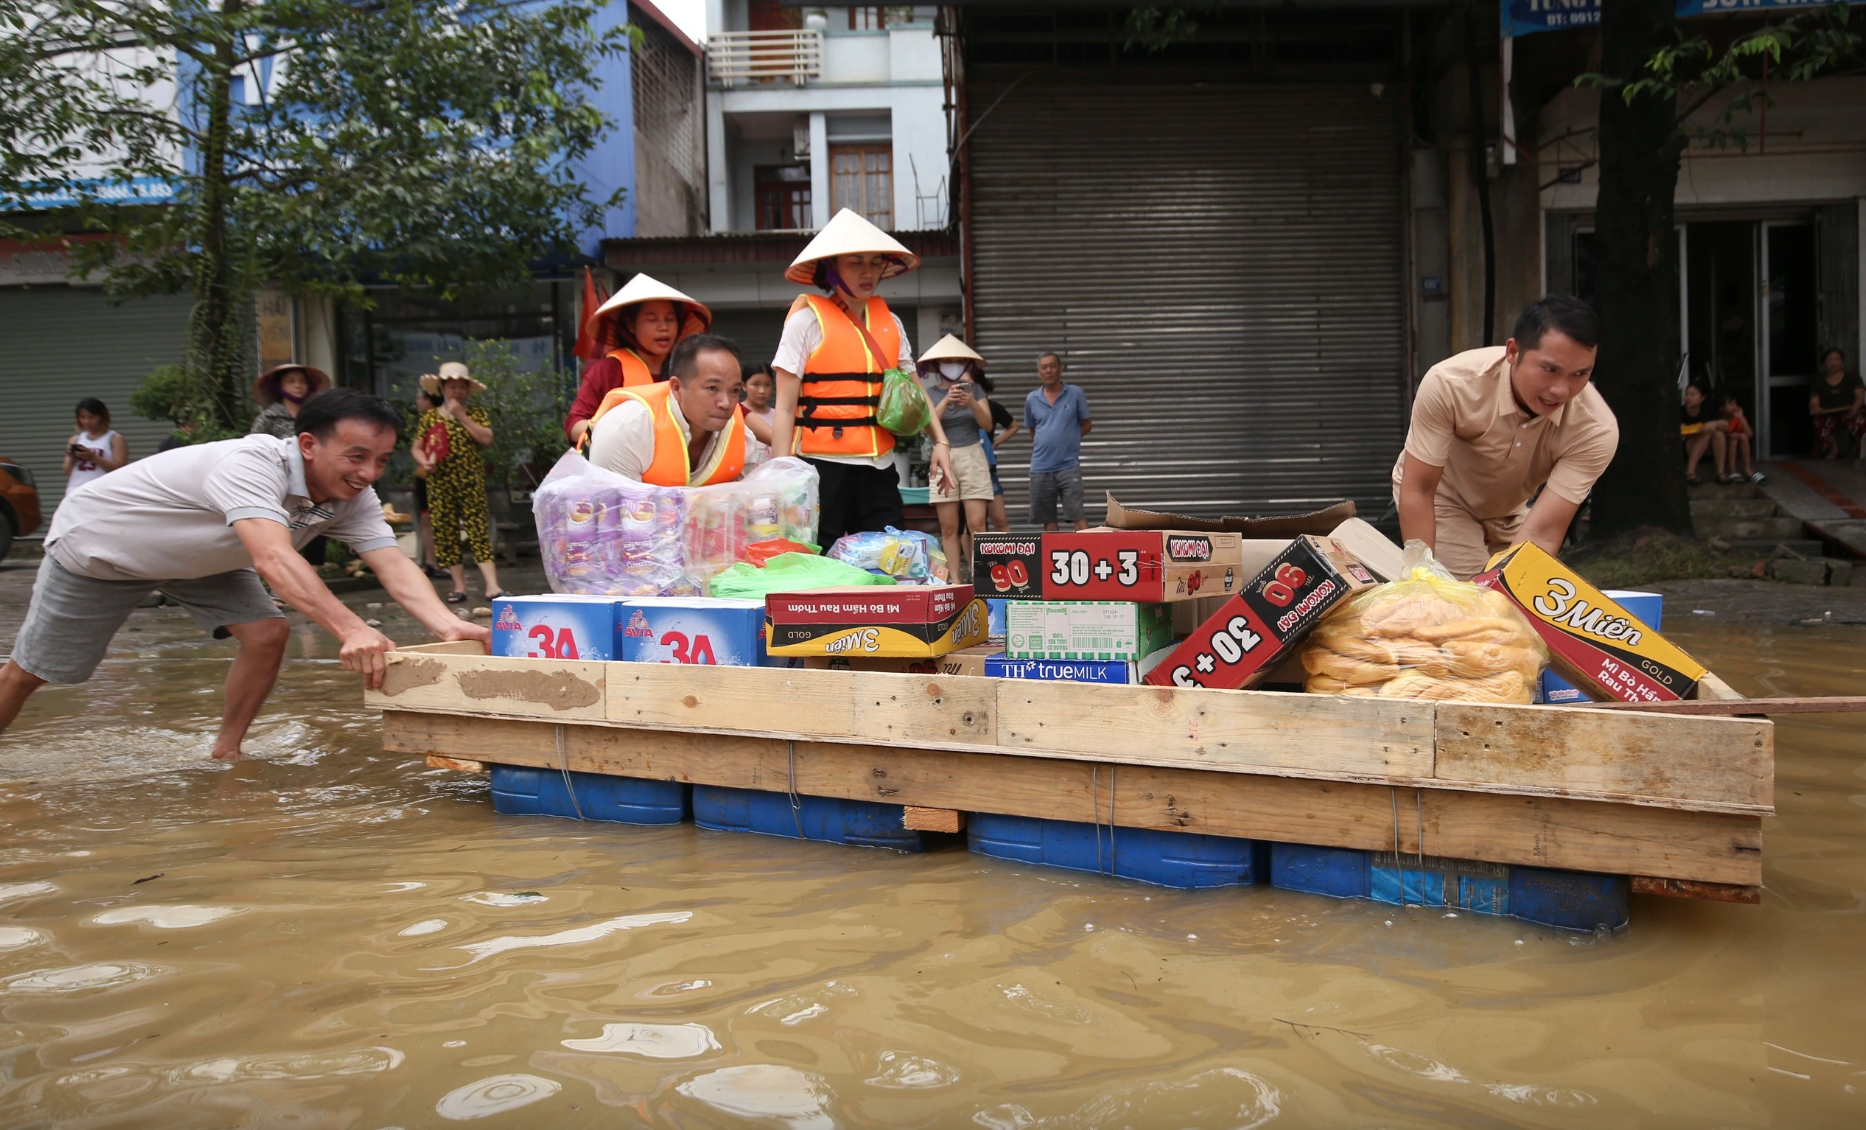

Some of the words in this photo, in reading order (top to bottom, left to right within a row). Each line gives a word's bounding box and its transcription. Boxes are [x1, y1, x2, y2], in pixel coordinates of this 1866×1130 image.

[980, 542, 1016, 554] KOKOMI
[1017, 542, 1036, 556] ĐẠI
[1171, 539, 1196, 558] KOKOMI
[990, 560, 1029, 592] 90
[1051, 550, 1090, 585] 30
[1094, 560, 1113, 582] +
[1118, 549, 1139, 586] 3
[1188, 569, 1201, 595] 90
[1263, 561, 1308, 607] 90
[1296, 579, 1336, 617] KOKOMI
[788, 604, 818, 614] Thơm
[820, 604, 841, 613] Rau
[844, 604, 867, 615] Hầm
[870, 604, 884, 614] Bò
[887, 604, 900, 614] Mì
[495, 621, 522, 631] AVIA
[1277, 611, 1298, 632] ĐẠI
[624, 627, 654, 638] AVIA
[788, 631, 812, 639] GOLD
[1210, 615, 1264, 665] 30
[1002, 664, 1026, 678] TH
[1601, 657, 1620, 675] Mì
[1617, 670, 1637, 688] Bò
[1641, 660, 1674, 687] GOLD
[1597, 670, 1623, 692] Rau
